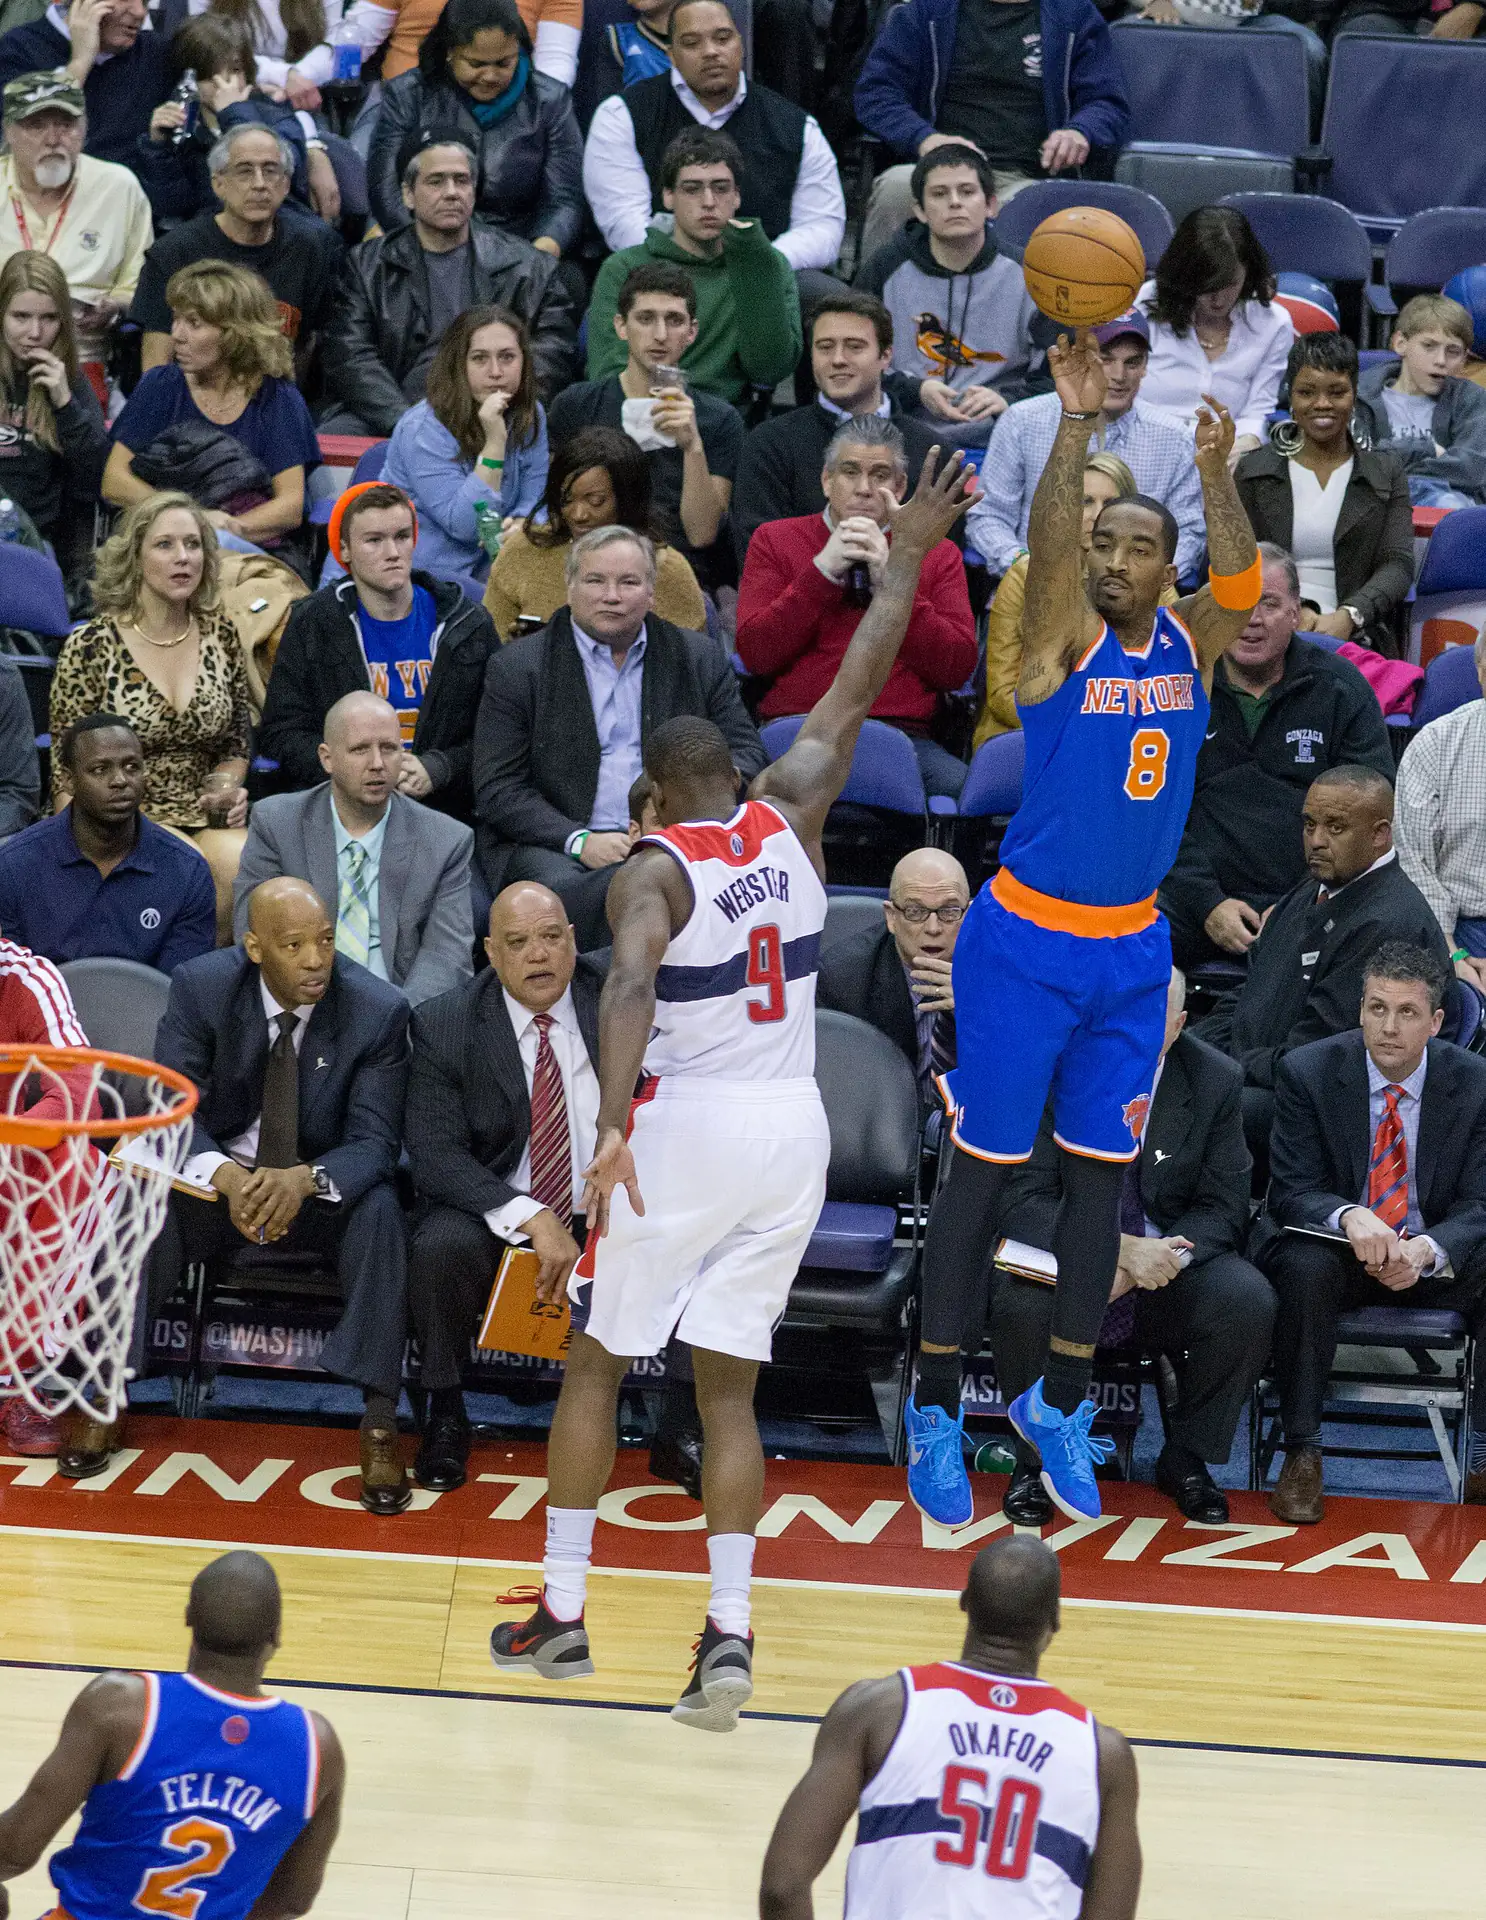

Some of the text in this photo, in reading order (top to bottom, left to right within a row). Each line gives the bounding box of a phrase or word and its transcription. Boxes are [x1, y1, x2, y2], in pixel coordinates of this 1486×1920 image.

[1136, 674, 1195, 716] YORK
[1123, 728, 1171, 801] 8
[1286, 729, 1324, 744] GONZAGA
[713, 866, 790, 924] WEBSTER
[745, 921, 788, 1026] 9
[948, 1721, 1053, 1773] OKAFOR
[160, 1772, 282, 1833] FELTON
[933, 1760, 1044, 1884] 50
[130, 1815, 236, 1920] 2
